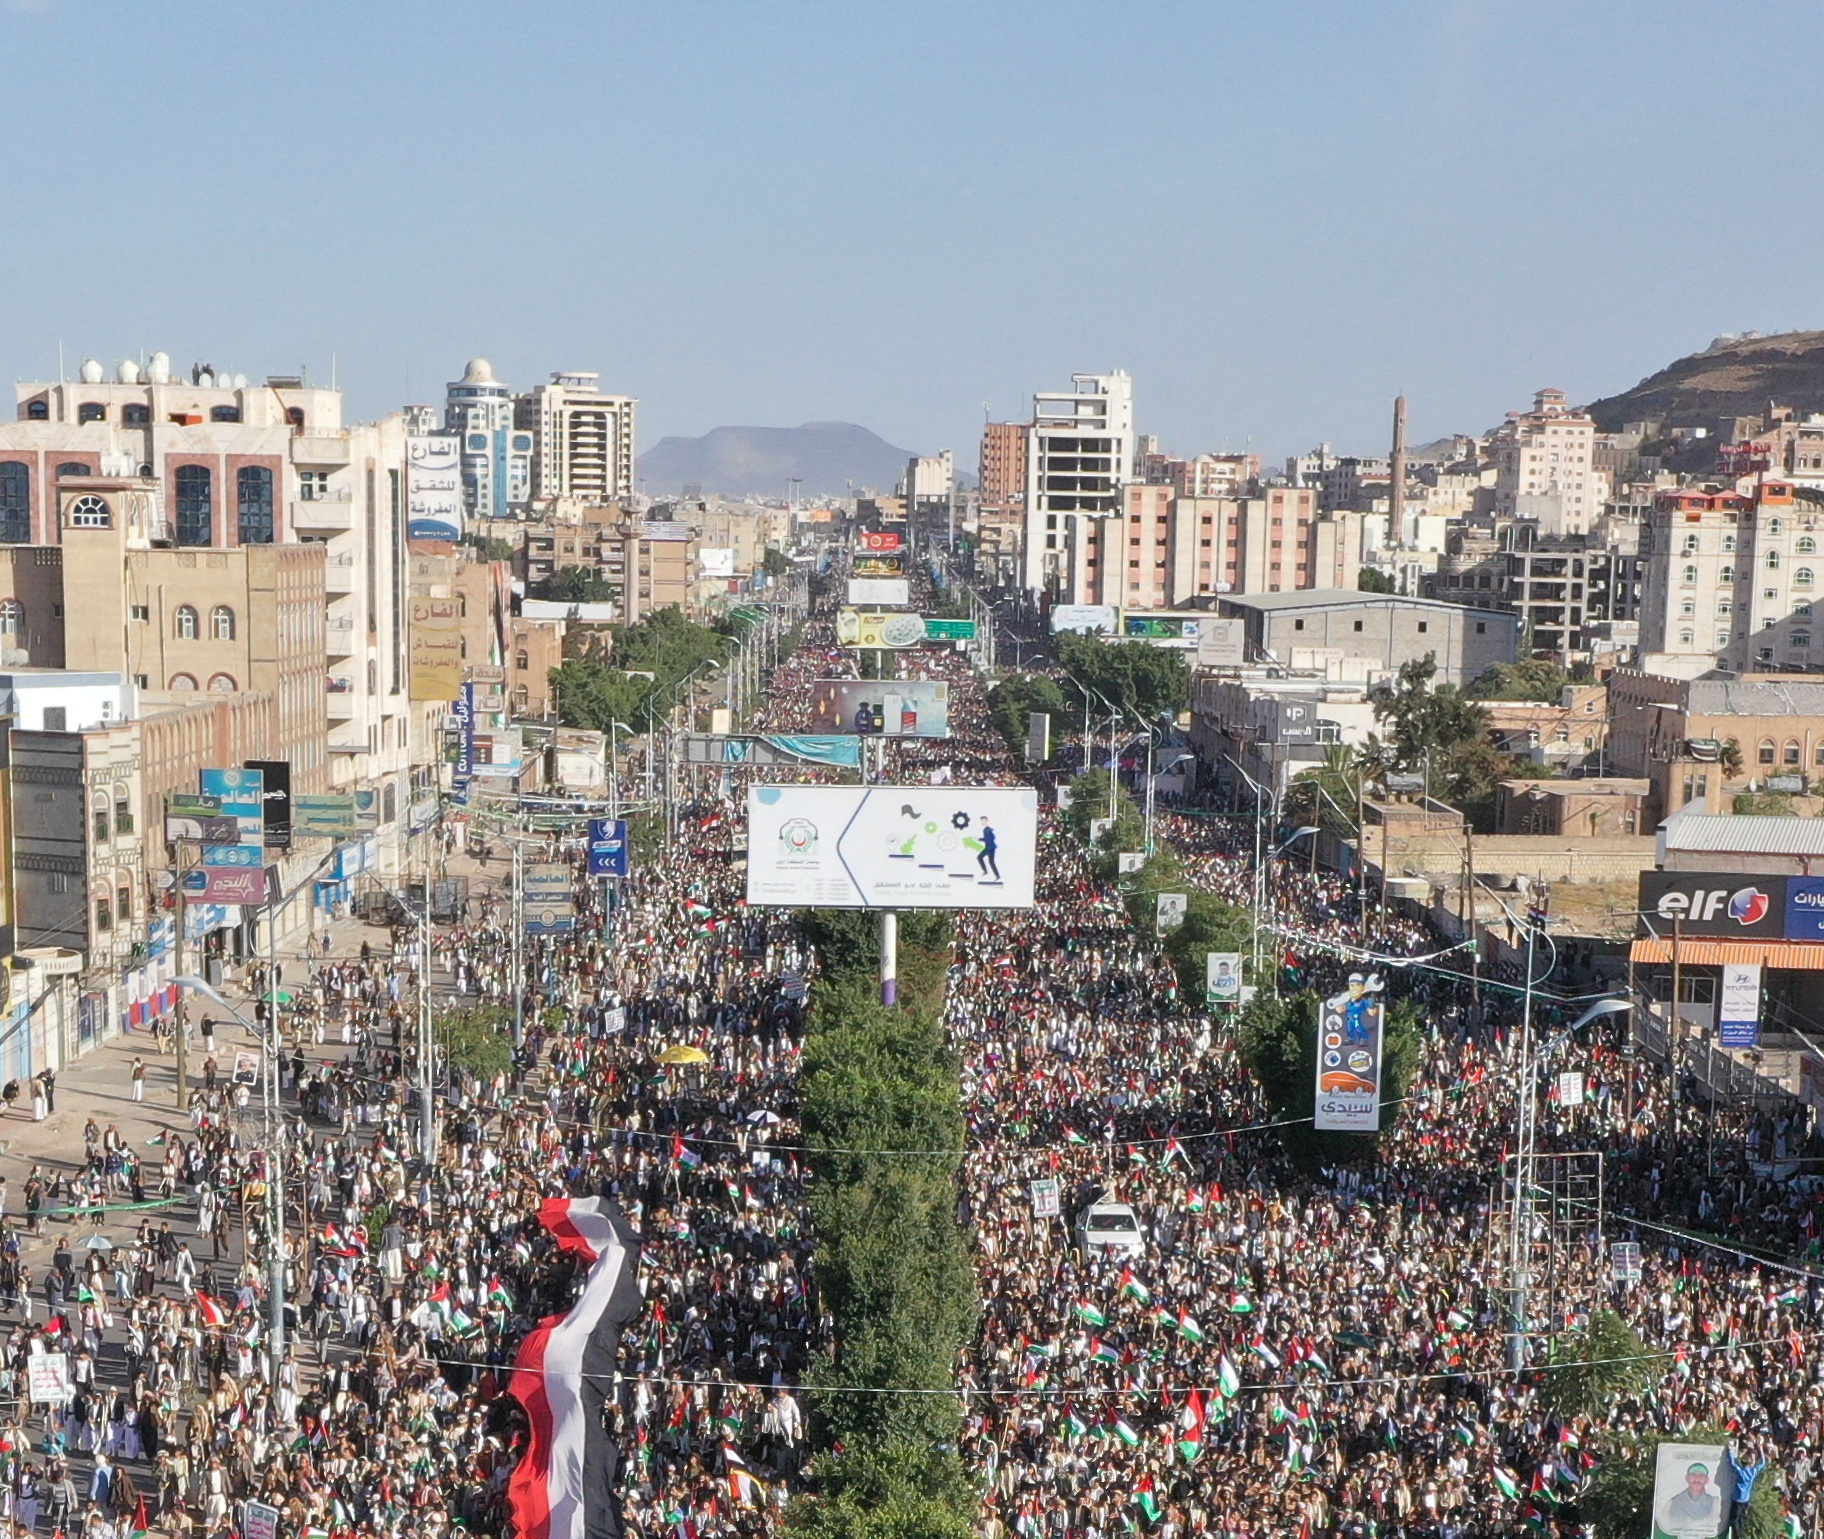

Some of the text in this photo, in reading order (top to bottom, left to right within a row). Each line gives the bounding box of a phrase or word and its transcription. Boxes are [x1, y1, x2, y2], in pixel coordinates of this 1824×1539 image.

[410, 480, 455, 493] للشقق
[411, 501, 456, 517] المفروشة
[1658, 890, 1727, 921] elf
